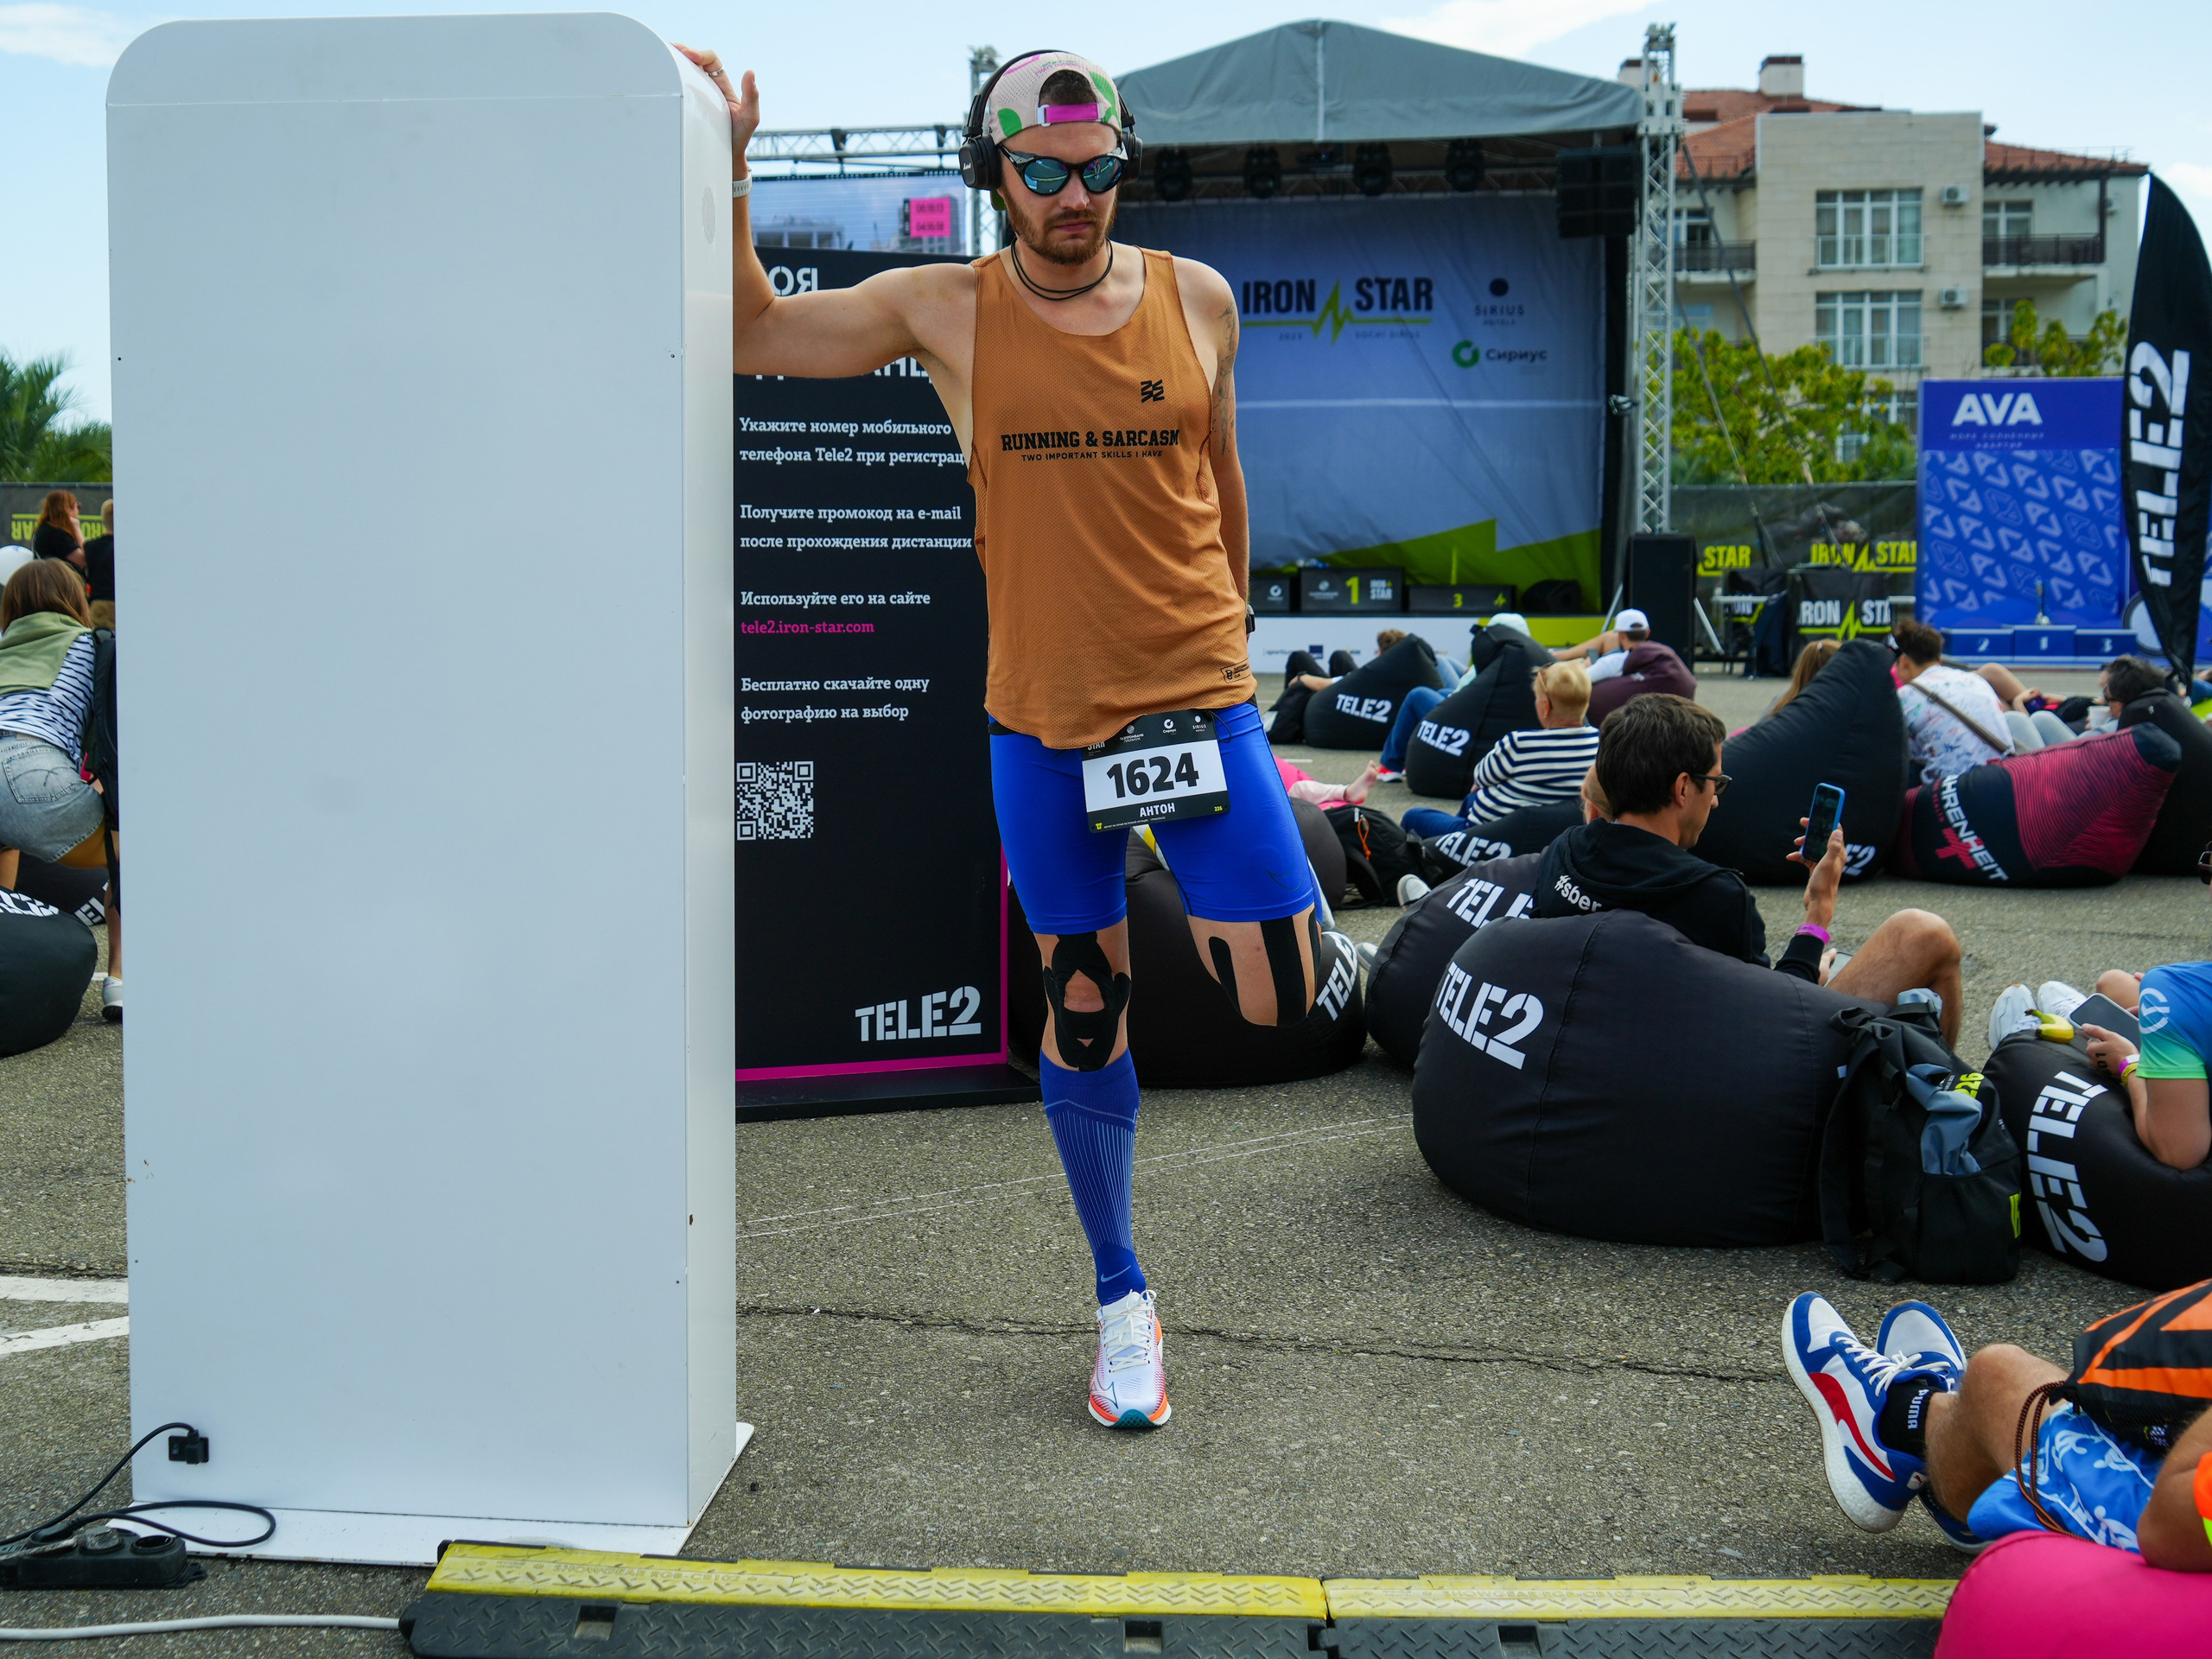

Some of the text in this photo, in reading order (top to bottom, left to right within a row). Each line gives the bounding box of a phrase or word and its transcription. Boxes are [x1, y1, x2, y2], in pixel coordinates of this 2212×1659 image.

[768, 266, 818, 296] ОЯ
[1242, 276, 1433, 315] IRON STAR
[1474, 304, 1525, 315] SIRIUS
[1486, 348, 1548, 363] Сириус
[1951, 393, 2044, 426] AVA
[739, 417, 952, 436] Укажите номер мобильного
[1001, 429, 1180, 451] RUNNING & SARCASM
[739, 447, 966, 467] телефона Tele2 при регистрац
[1021, 454, 1043, 462] TWO
[1046, 451, 1098, 461] IMPORTANT
[2129, 341, 2190, 587] TELE2
[740, 505, 962, 523] Получите промокод на e-mail
[740, 537, 972, 551] после прохождения дистанции
[1704, 544, 1751, 569] STAR
[741, 591, 931, 608] Используйте его на сайте
[1345, 576, 1359, 604] 1
[1453, 593, 1463, 607] 3
[1800, 599, 1891, 625] RON STA
[741, 620, 875, 633] tele2.iron-star.com
[741, 677, 931, 692] Бесплатно скачайте одну
[741, 703, 910, 723] фотографию на выбор
[1336, 694, 1392, 723] TELE2
[1416, 720, 1471, 756] TELE2
[1106, 752, 1199, 799] 1624
[1139, 803, 1176, 817] АНТОН
[1446, 877, 1534, 929] TELE
[1554, 875, 1603, 912] #sber
[1316, 931, 1357, 1021] TELE
[855, 985, 982, 1041] TELE2
[1436, 961, 1544, 1070] TELE2
[2027, 1071, 2108, 1262] TELE2
[1907, 1389, 1929, 1430] PUMA
